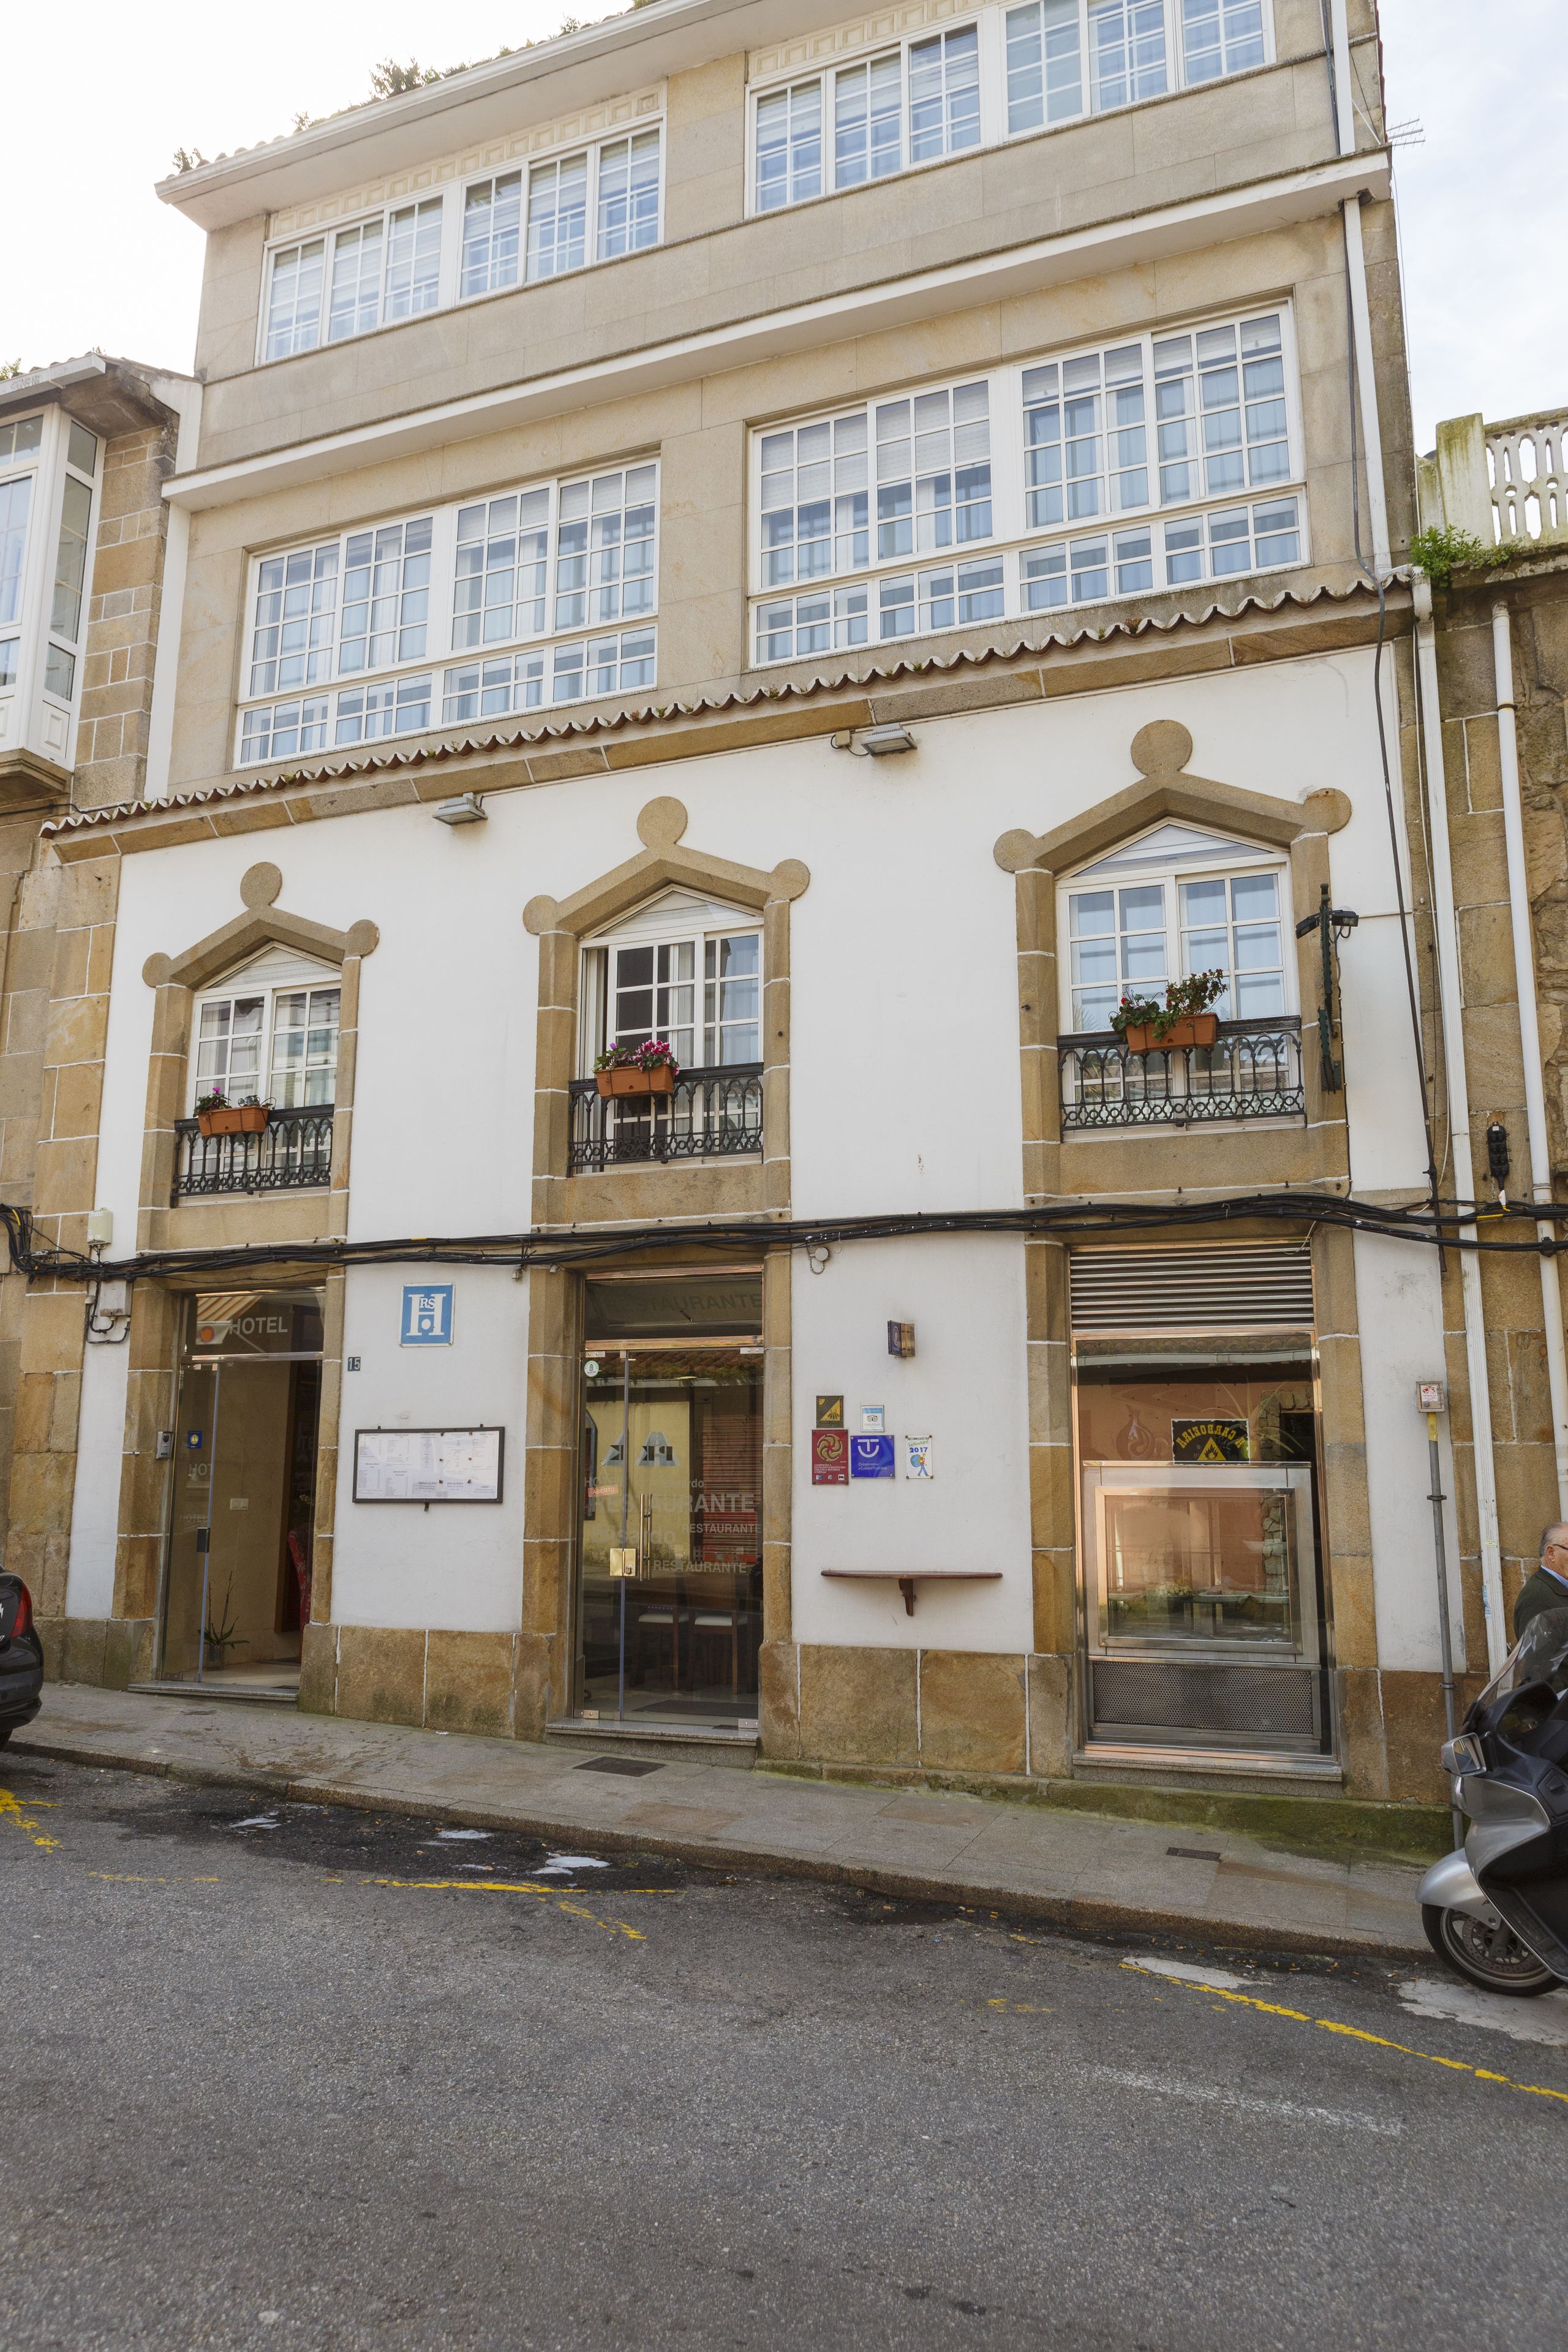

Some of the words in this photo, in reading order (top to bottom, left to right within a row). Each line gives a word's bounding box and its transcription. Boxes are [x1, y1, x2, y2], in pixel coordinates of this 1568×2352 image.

[420, 1297, 435, 1309] RS
[406, 1293, 447, 1336] H
[229, 1317, 288, 1335] HOTEL
[348, 1357, 360, 1371] 15
[682, 1523, 761, 1534] RESTAURANTE
[653, 1559, 747, 1574] RESTAURANTE
